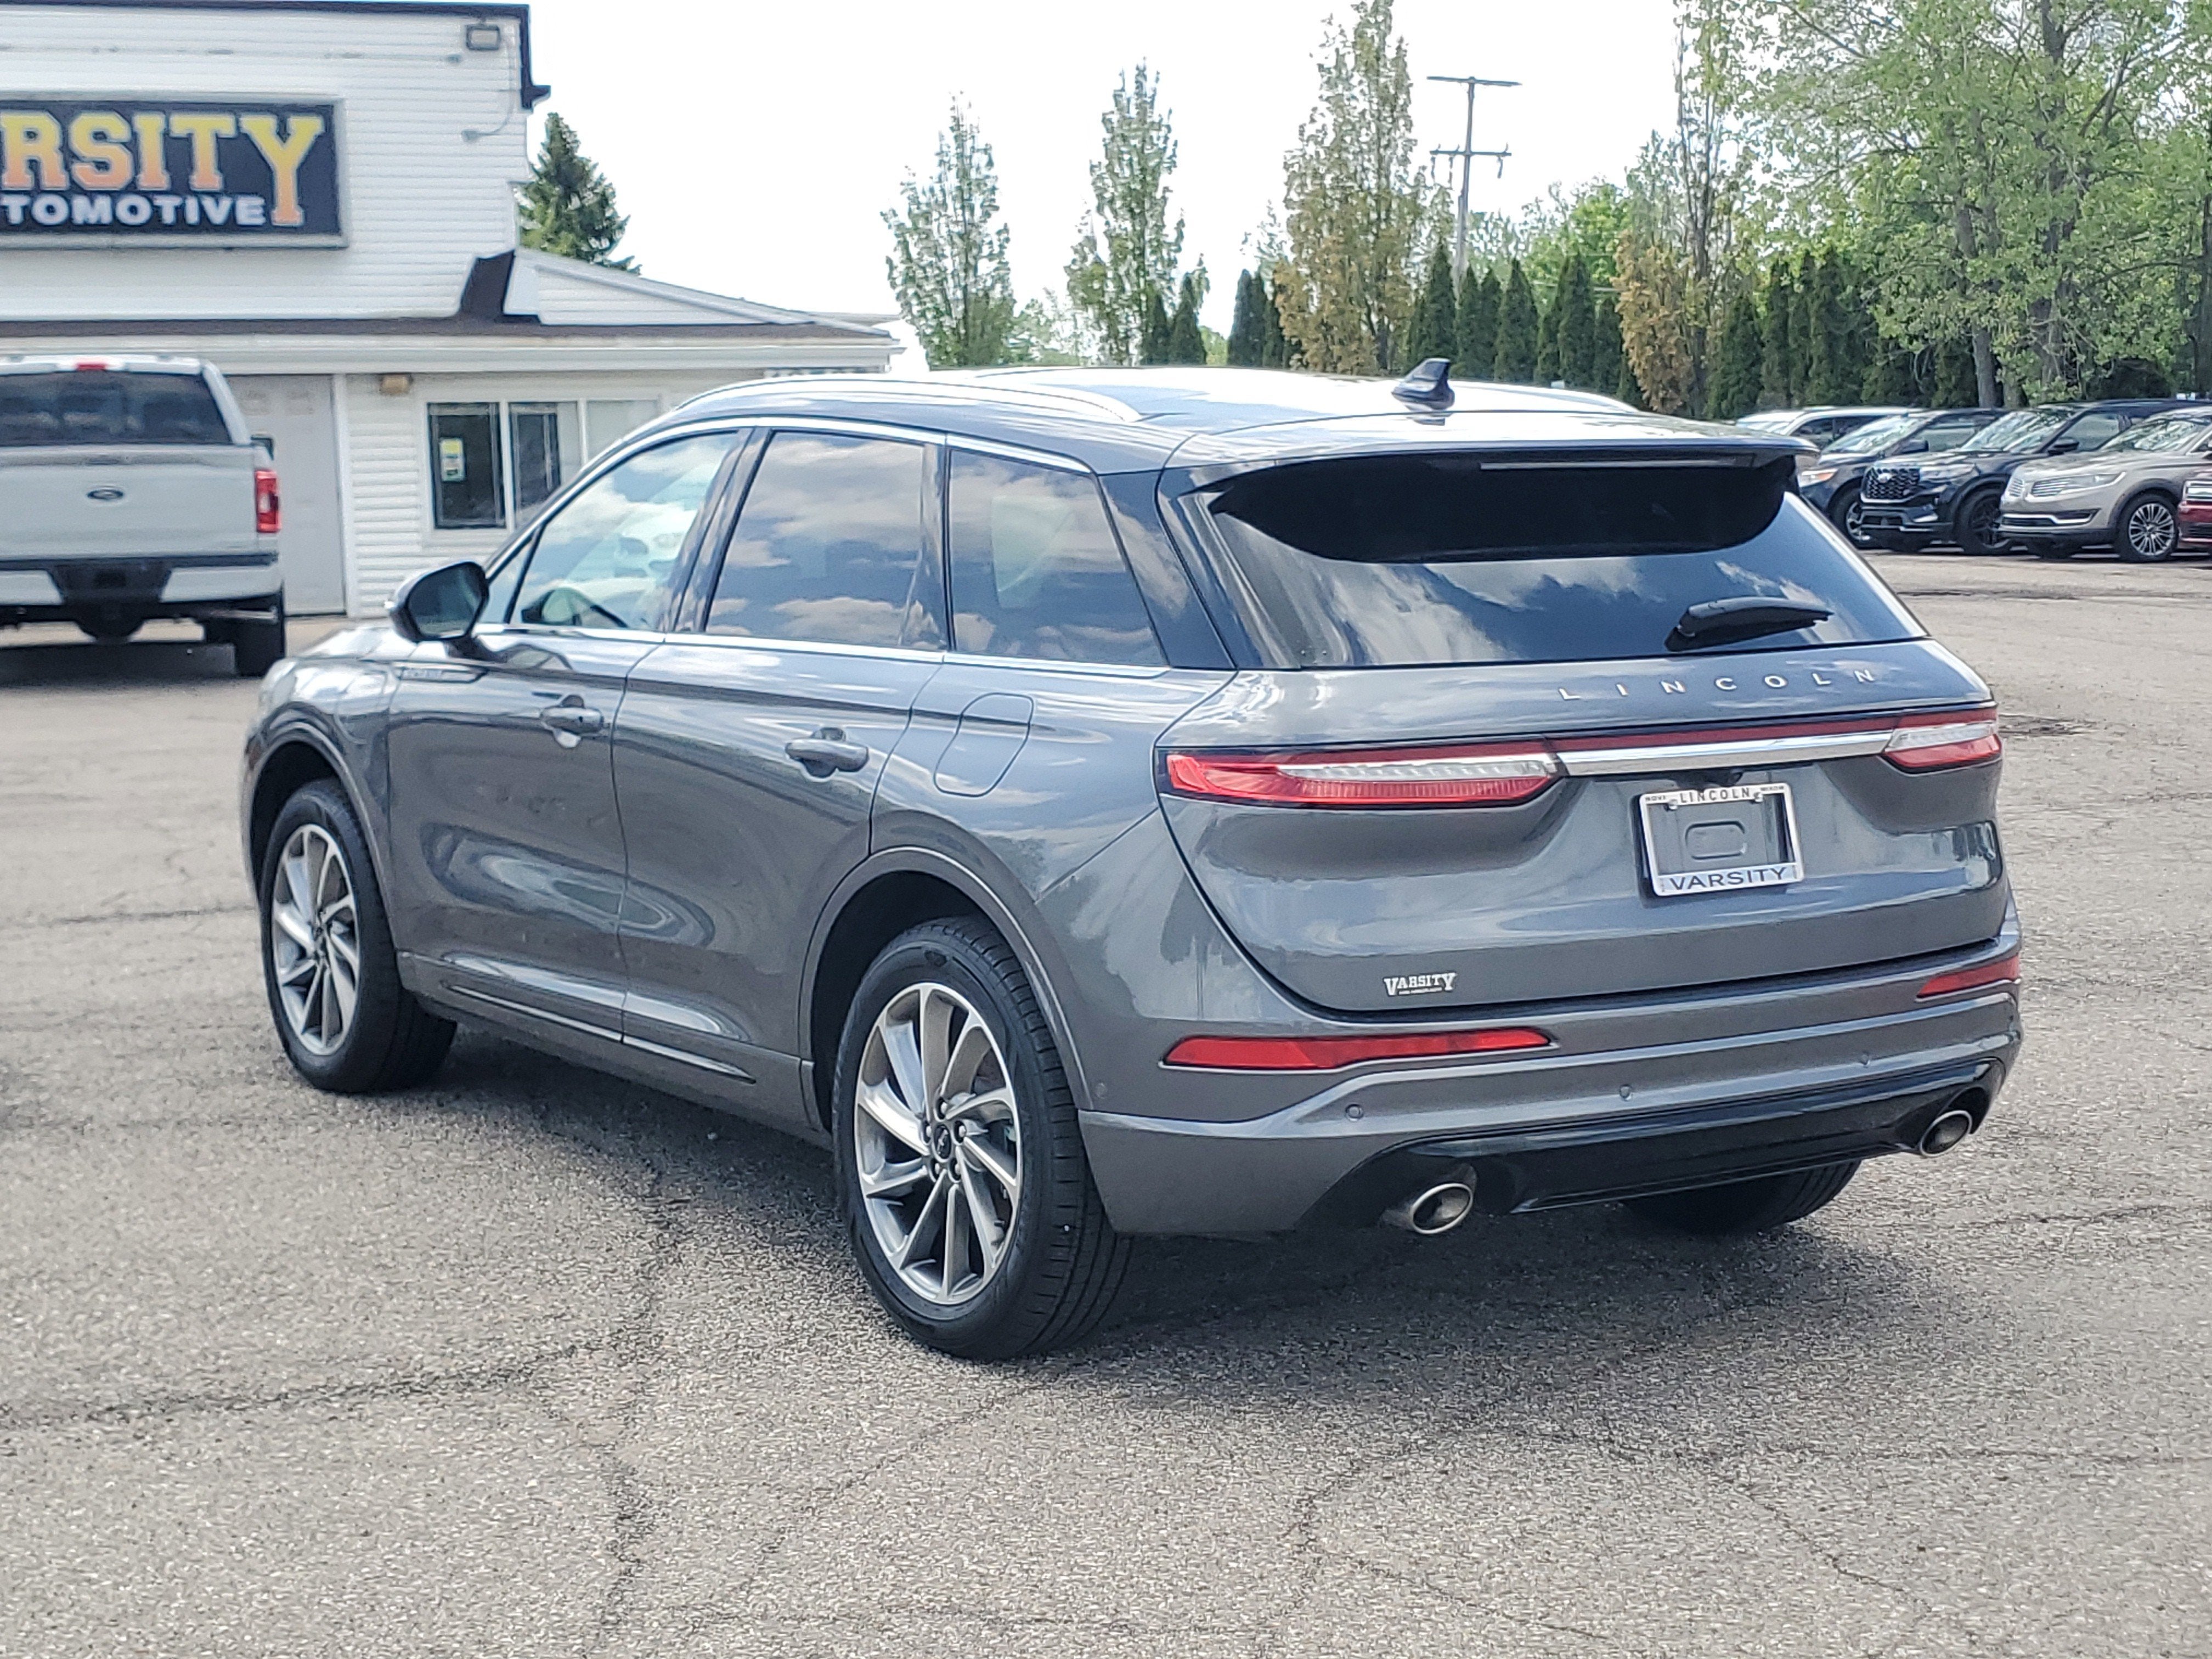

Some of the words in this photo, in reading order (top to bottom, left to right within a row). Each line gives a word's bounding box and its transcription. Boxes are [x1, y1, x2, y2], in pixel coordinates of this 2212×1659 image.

[0, 111, 326, 227] RSITY
[0, 195, 266, 225] TOMOTIVE
[1559, 669, 1875, 701] LINCOLN
[1679, 787, 1750, 803] LINCOLN
[1669, 867, 1786, 890] VARSITY
[1384, 972, 1457, 996] VARSITY
